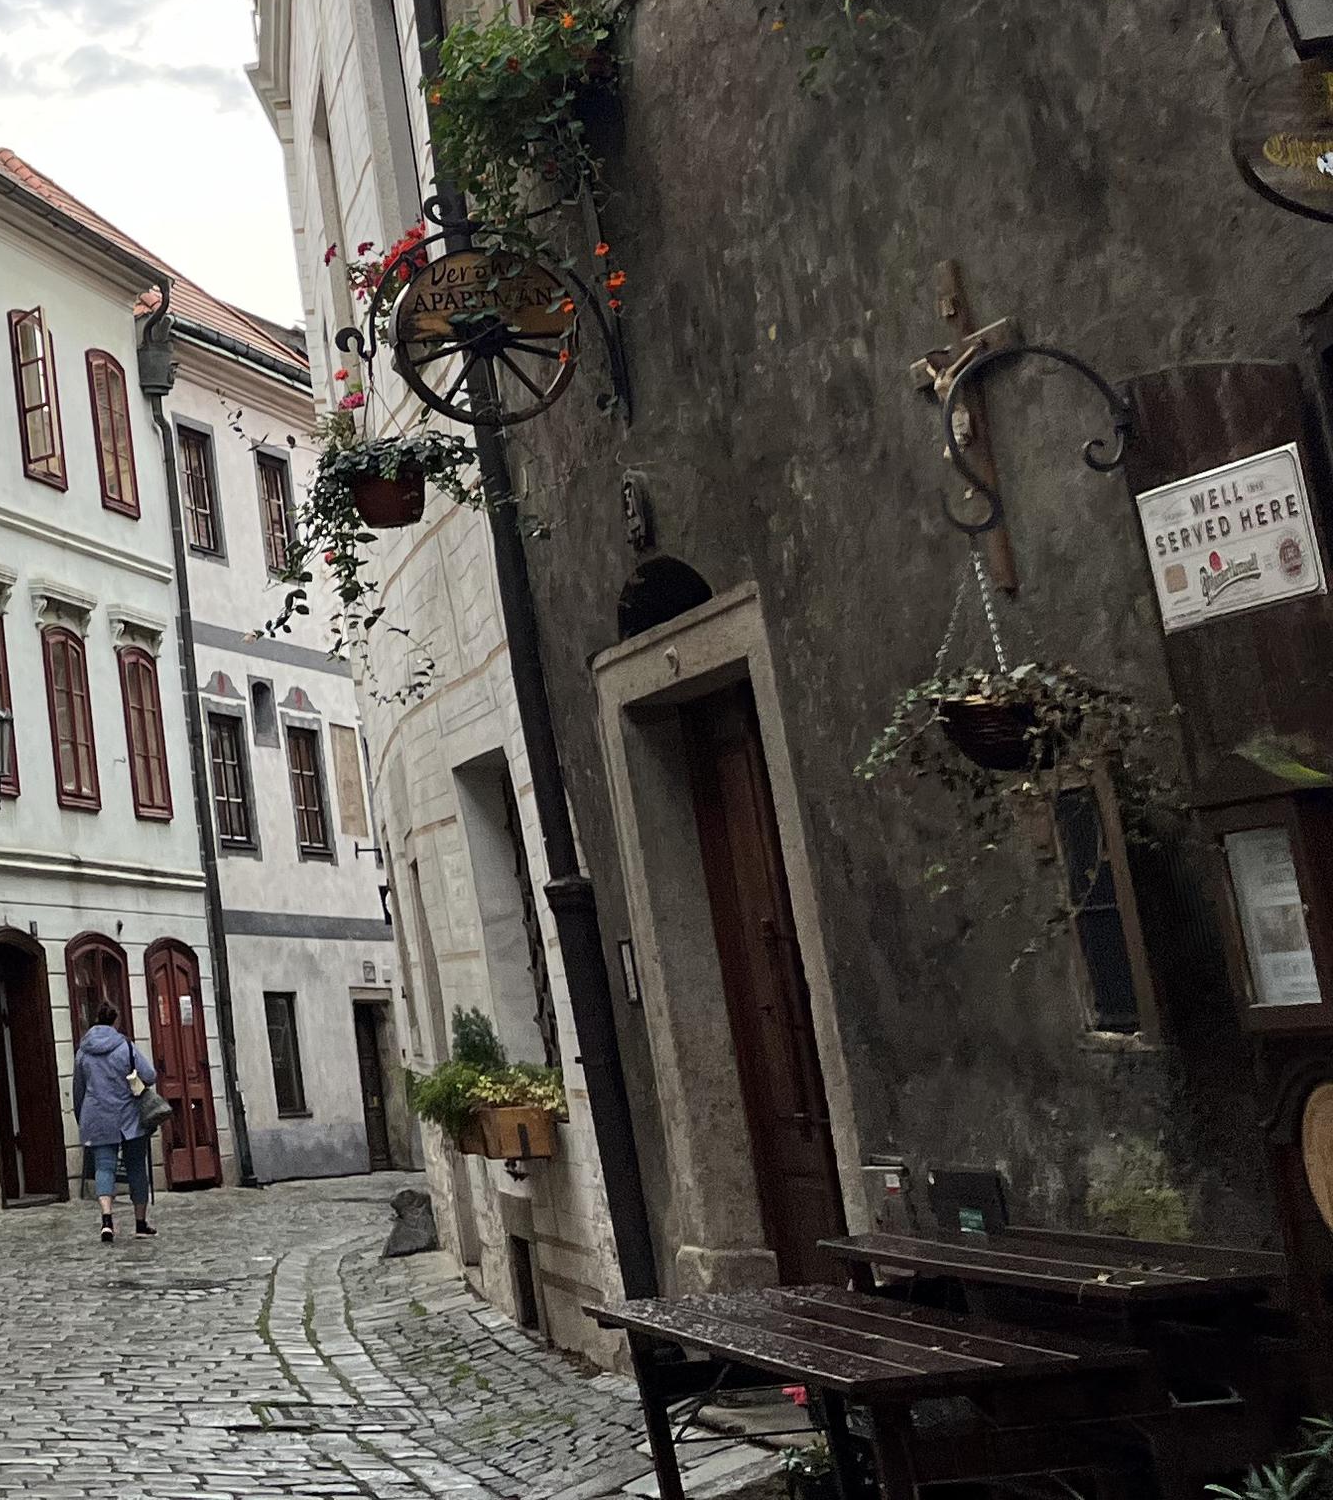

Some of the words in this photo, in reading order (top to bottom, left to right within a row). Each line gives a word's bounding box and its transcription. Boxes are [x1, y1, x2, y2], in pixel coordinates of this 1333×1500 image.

[1189, 481, 1244, 516] WELL
[1155, 515, 1232, 556] SERVED
[1239, 494, 1302, 532] HERE
